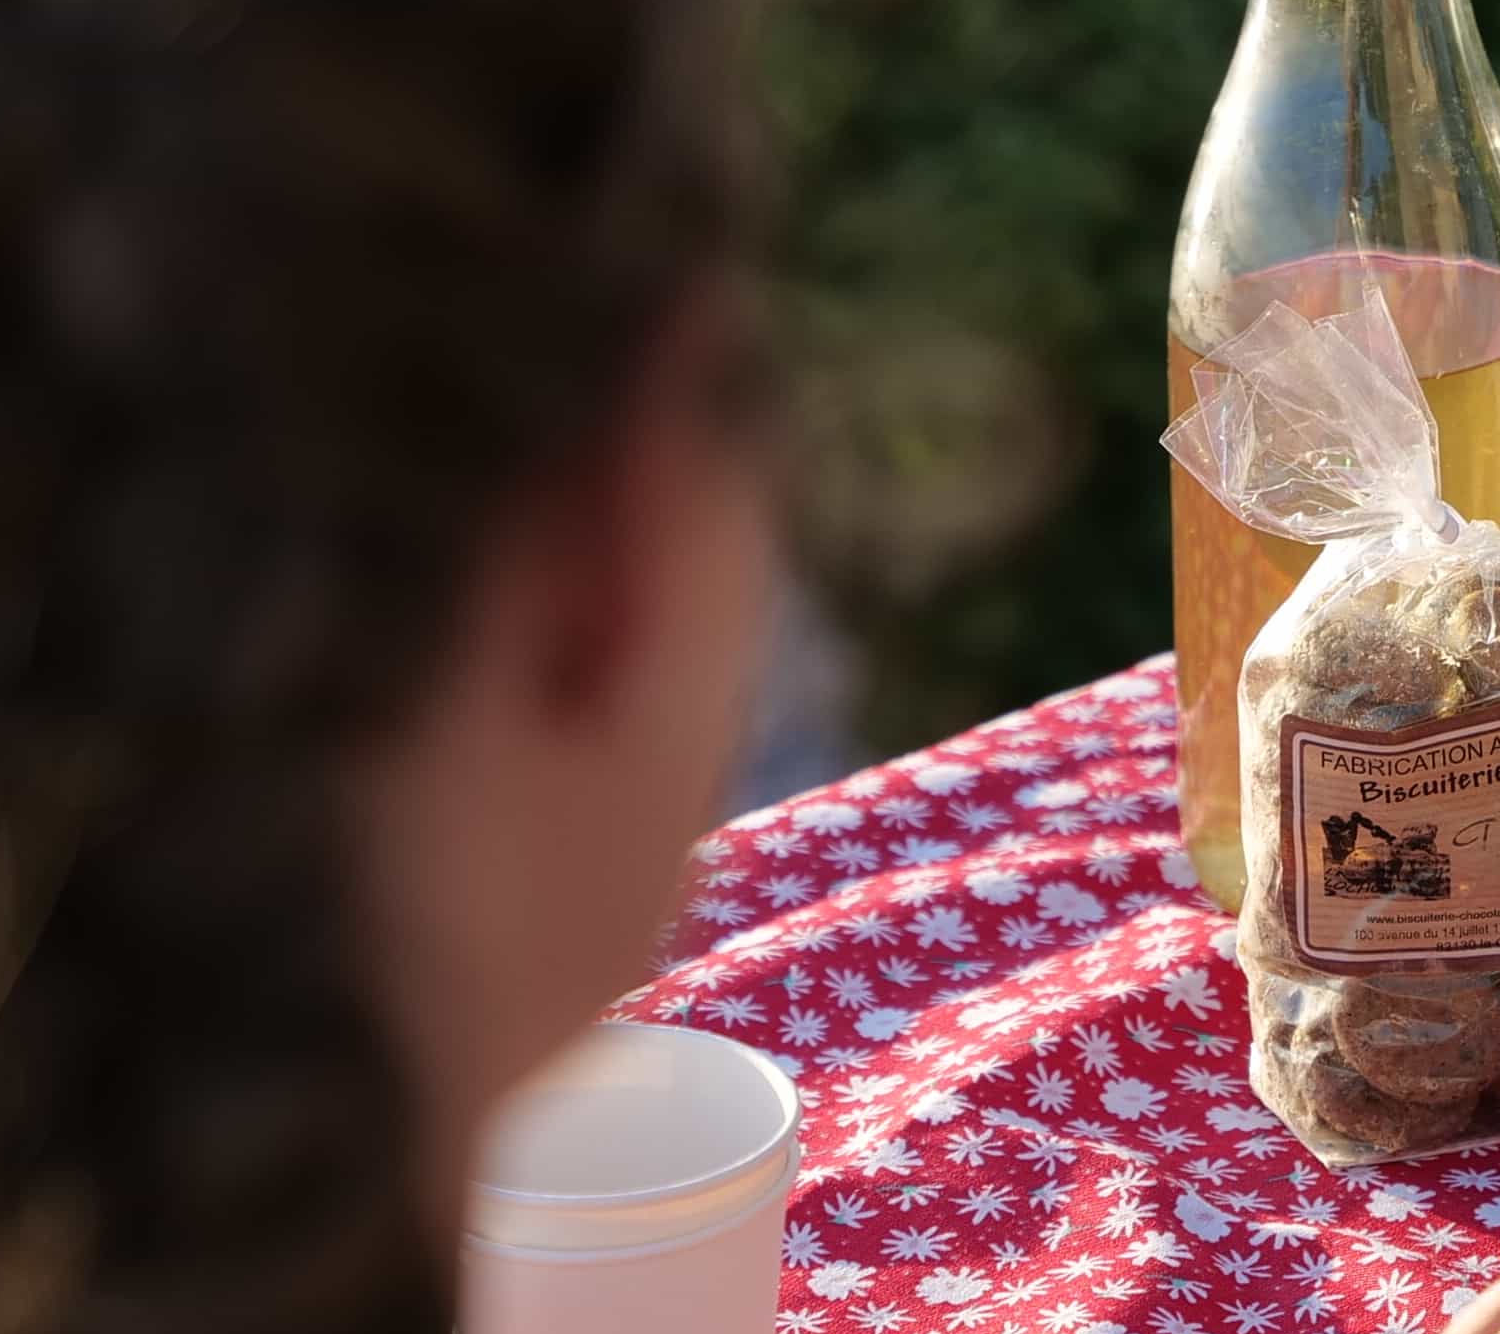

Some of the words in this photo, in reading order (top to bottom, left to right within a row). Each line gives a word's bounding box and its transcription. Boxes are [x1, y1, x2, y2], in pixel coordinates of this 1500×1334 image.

[1320, 740, 1483, 777] FABRICATION
[1377, 929, 1420, 940] avenue
[1423, 927, 1438, 940] du
[1443, 926, 1455, 938] 14
